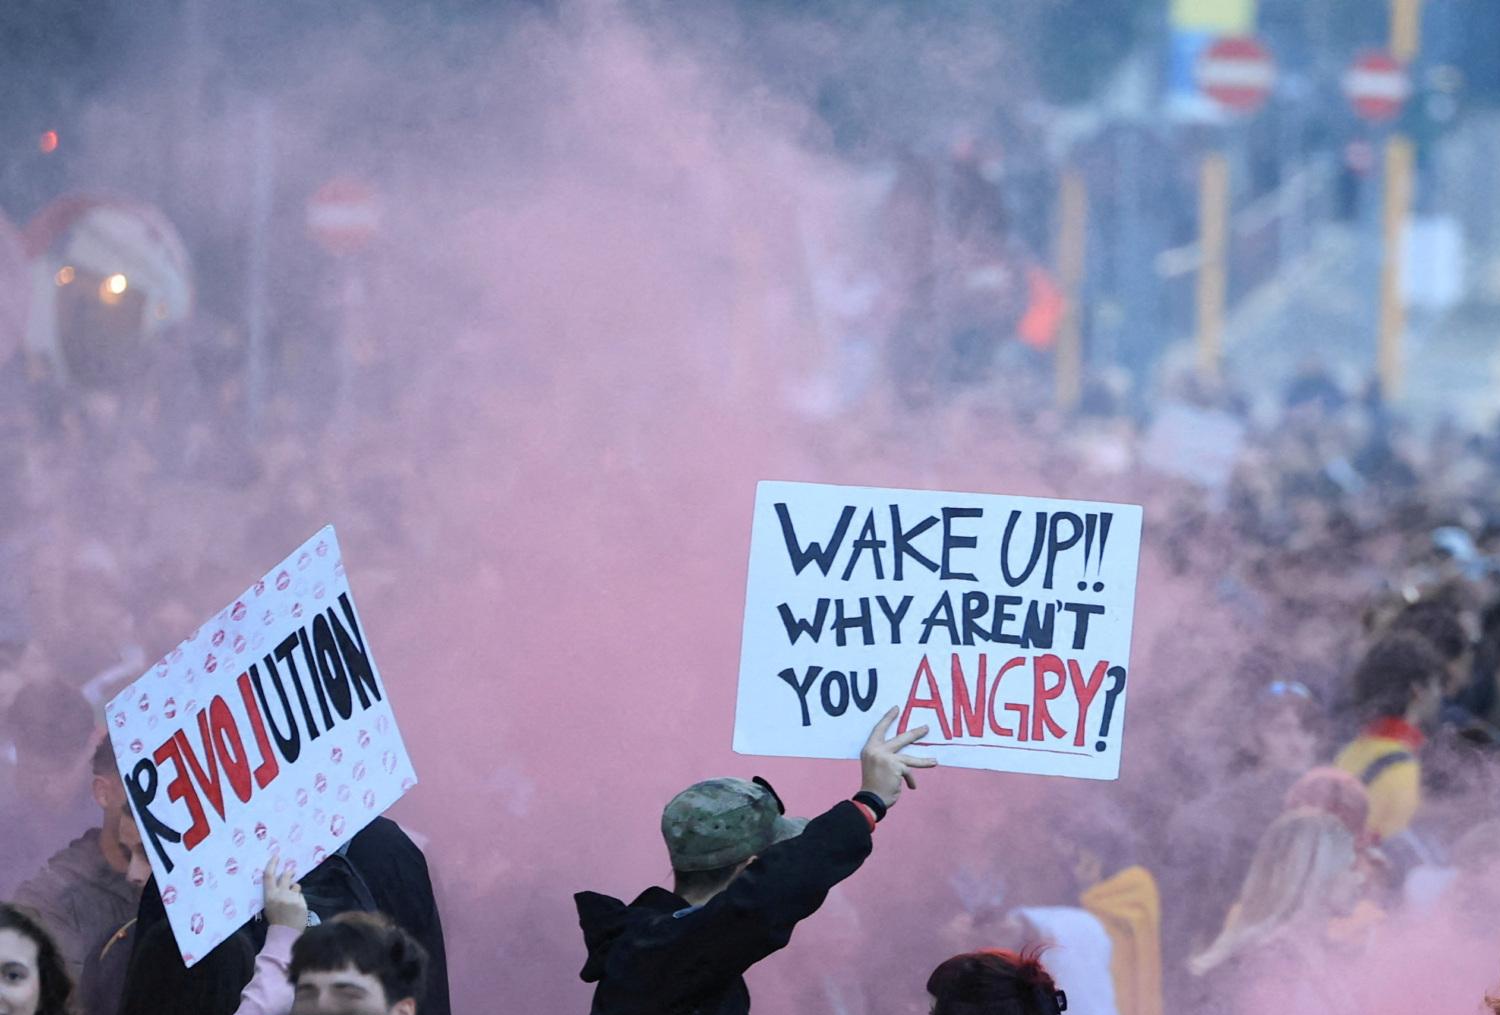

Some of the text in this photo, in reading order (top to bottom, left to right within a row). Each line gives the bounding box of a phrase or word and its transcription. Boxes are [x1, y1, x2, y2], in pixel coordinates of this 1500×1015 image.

[774, 503, 1113, 592] WAKE UP!!
[776, 590, 1105, 649] WHY AREN'T
[777, 653, 1127, 752] YOU ANGRY?
